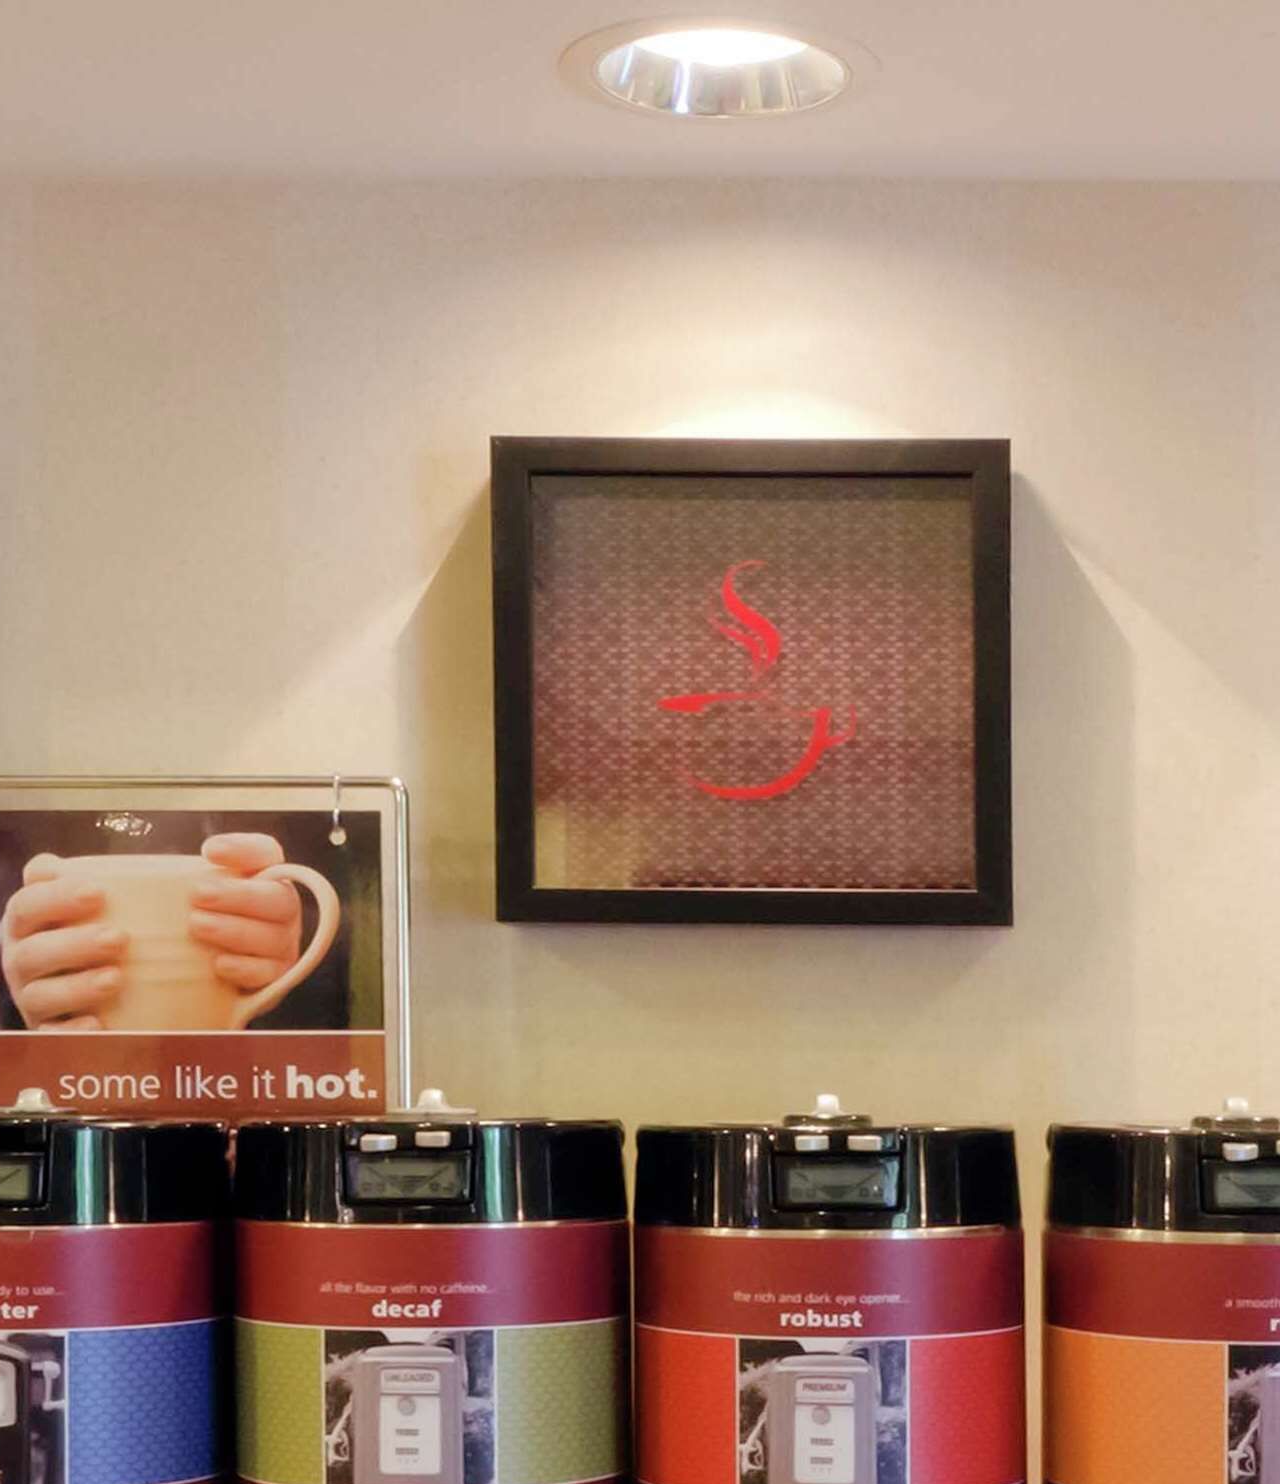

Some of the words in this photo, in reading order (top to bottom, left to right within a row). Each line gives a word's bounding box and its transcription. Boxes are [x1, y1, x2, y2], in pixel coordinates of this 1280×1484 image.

[59, 1074, 160, 1099] some
[176, 1065, 238, 1099] like
[252, 1066, 276, 1099] it
[286, 1065, 377, 1099] hot.
[16, 1285, 29, 1295] to
[334, 1283, 352, 1293] the
[355, 1283, 387, 1293] flavor
[391, 1283, 417, 1294] with
[421, 1285, 437, 1294] no
[733, 1290, 751, 1302] the
[754, 1291, 776, 1303] rich
[779, 1292, 801, 1303] and
[804, 1292, 830, 1303] dark
[836, 1294, 857, 1306] eye
[1225, 1299, 1233, 1308] a
[372, 1299, 442, 1317] decaf
[780, 1309, 863, 1327] robust
